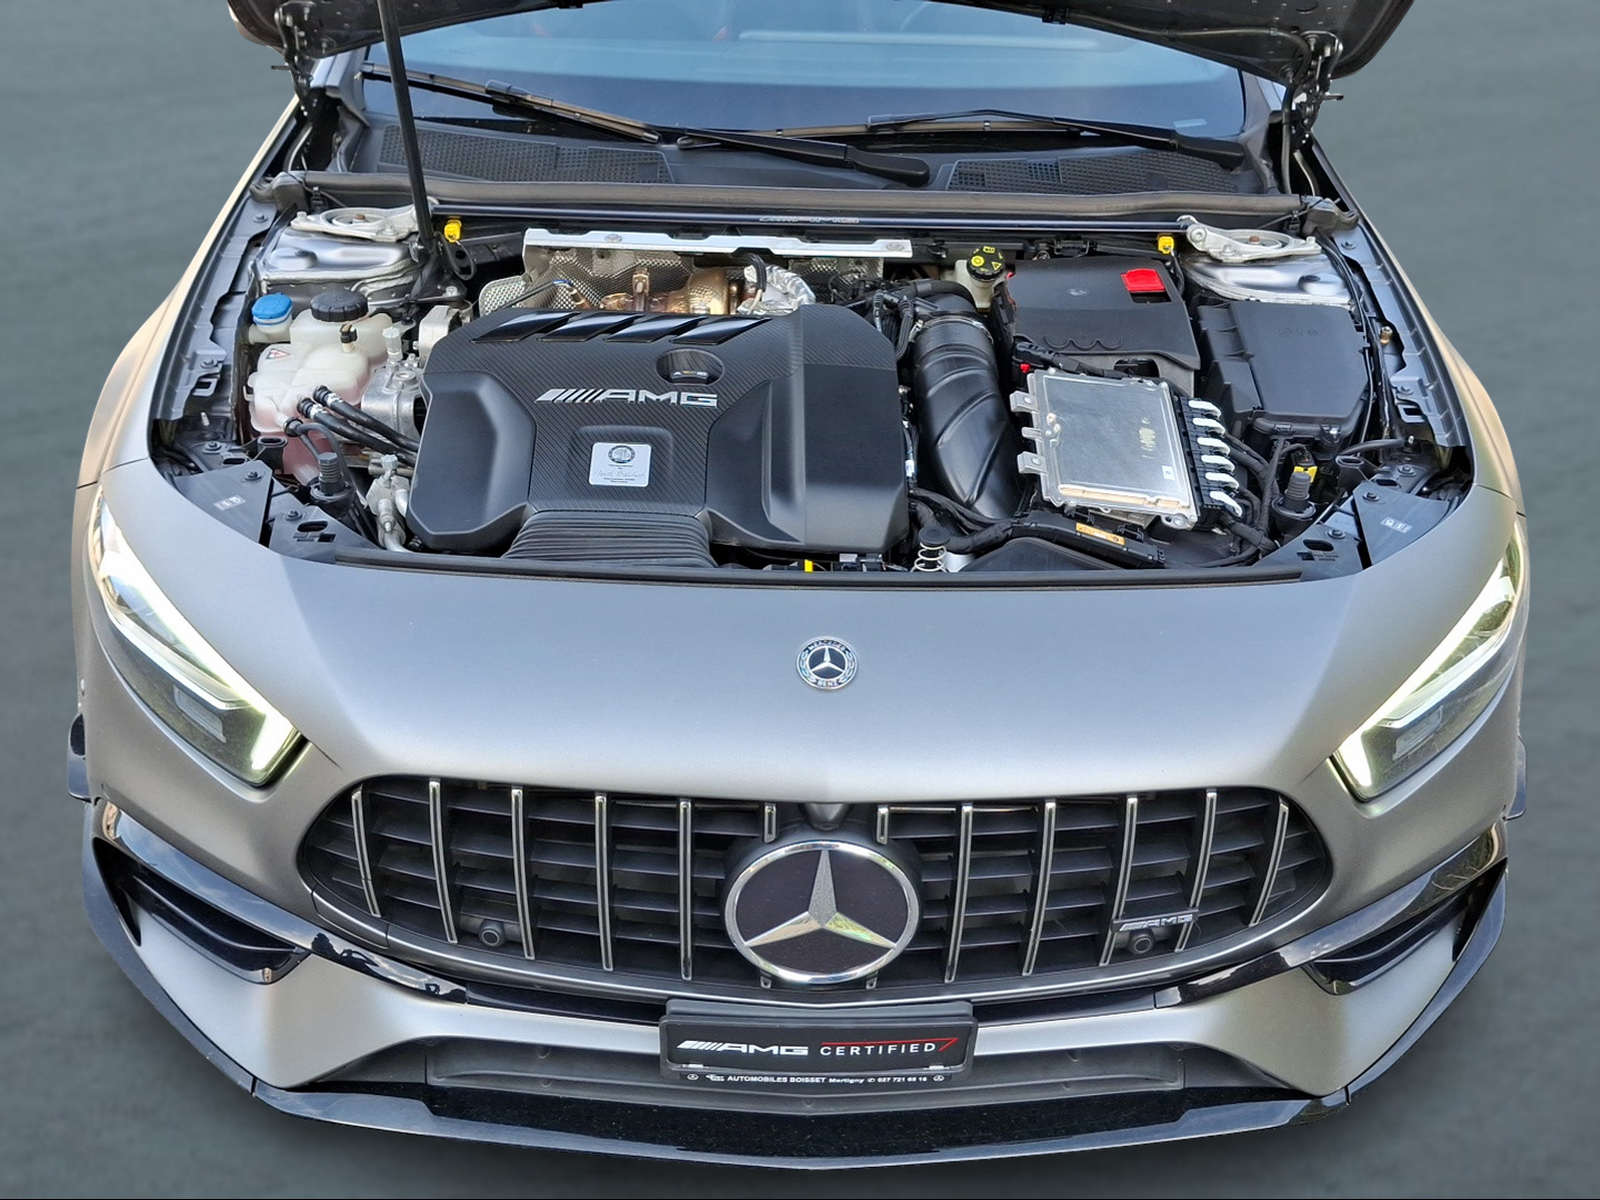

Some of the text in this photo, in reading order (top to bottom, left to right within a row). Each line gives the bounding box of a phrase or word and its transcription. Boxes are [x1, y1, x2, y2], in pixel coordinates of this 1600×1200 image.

[600, 388, 718, 408] AMG
[716, 1042, 936, 1056] AMG CERTIFIED
[727, 1075, 788, 1083] AUTOMOBILES
